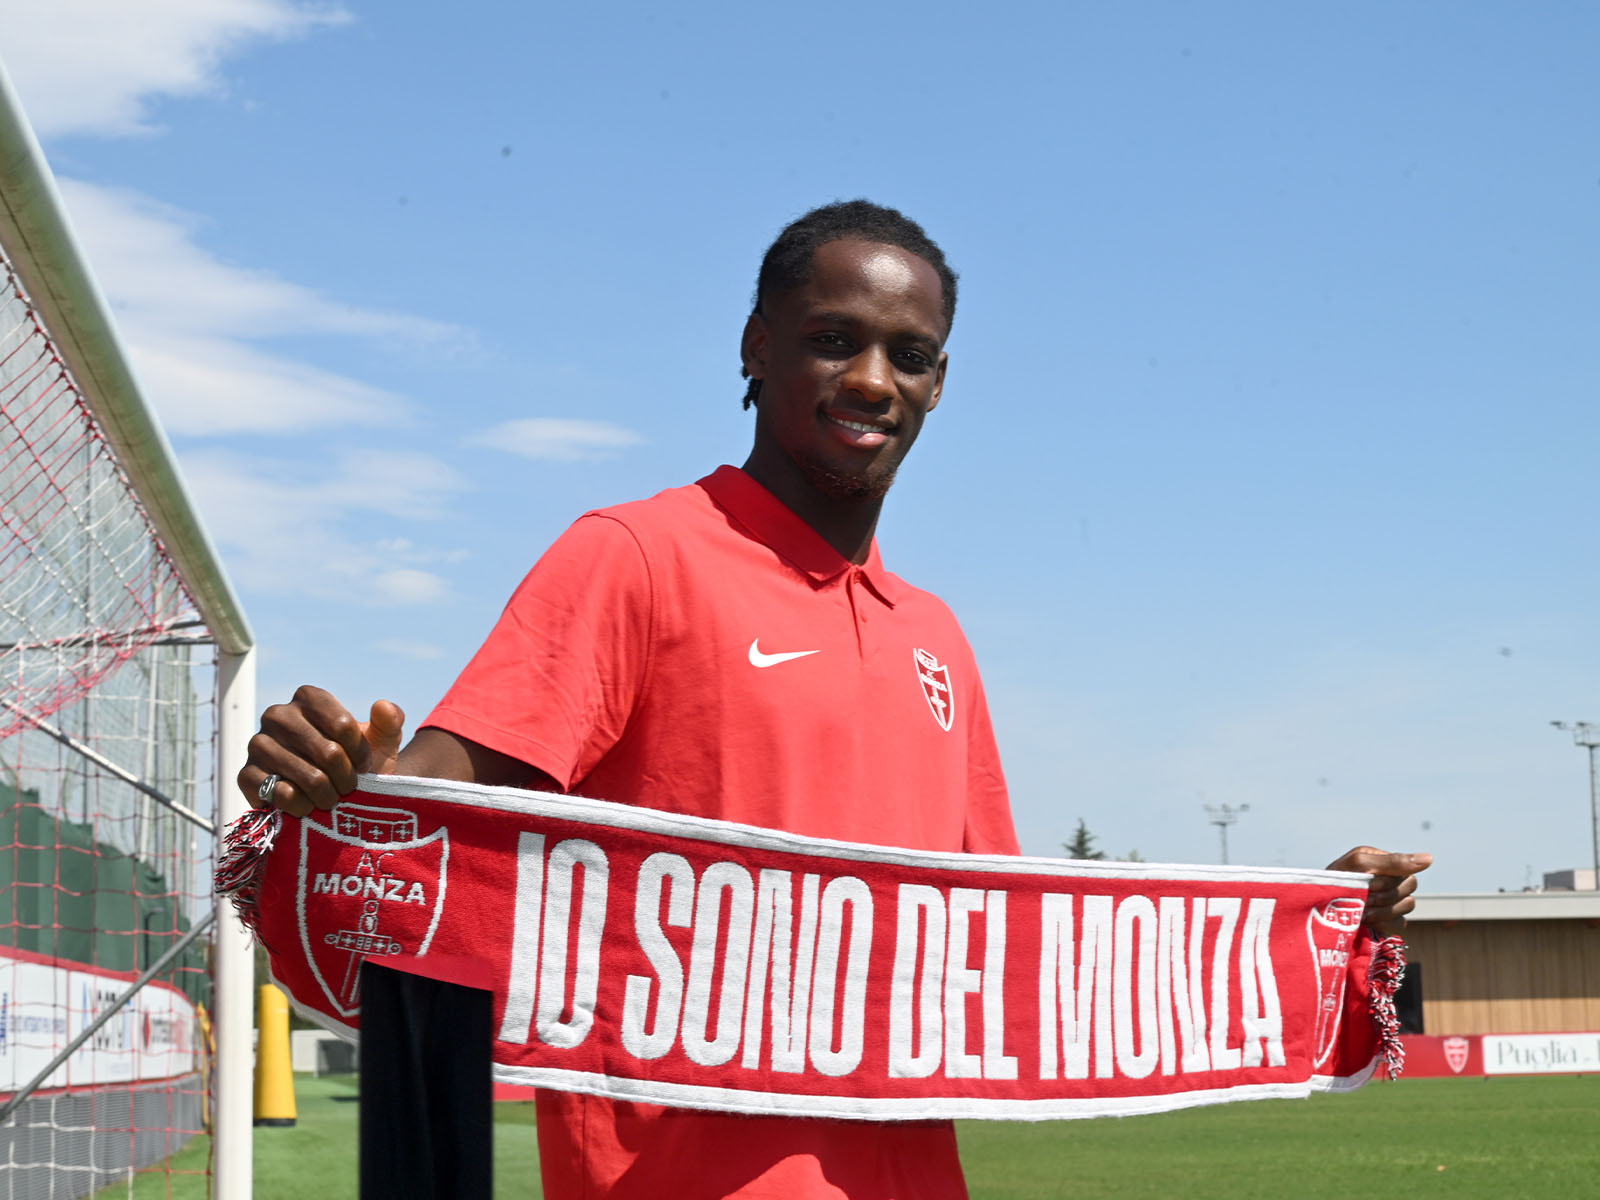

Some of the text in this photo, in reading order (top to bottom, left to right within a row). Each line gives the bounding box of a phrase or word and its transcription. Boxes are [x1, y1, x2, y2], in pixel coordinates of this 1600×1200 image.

[355, 851, 395, 877] AC
[312, 873, 427, 906] MONZA
[497, 831, 1286, 1080] IO SONO DEL MONZA
[1498, 1039, 1577, 1070] Puglia
